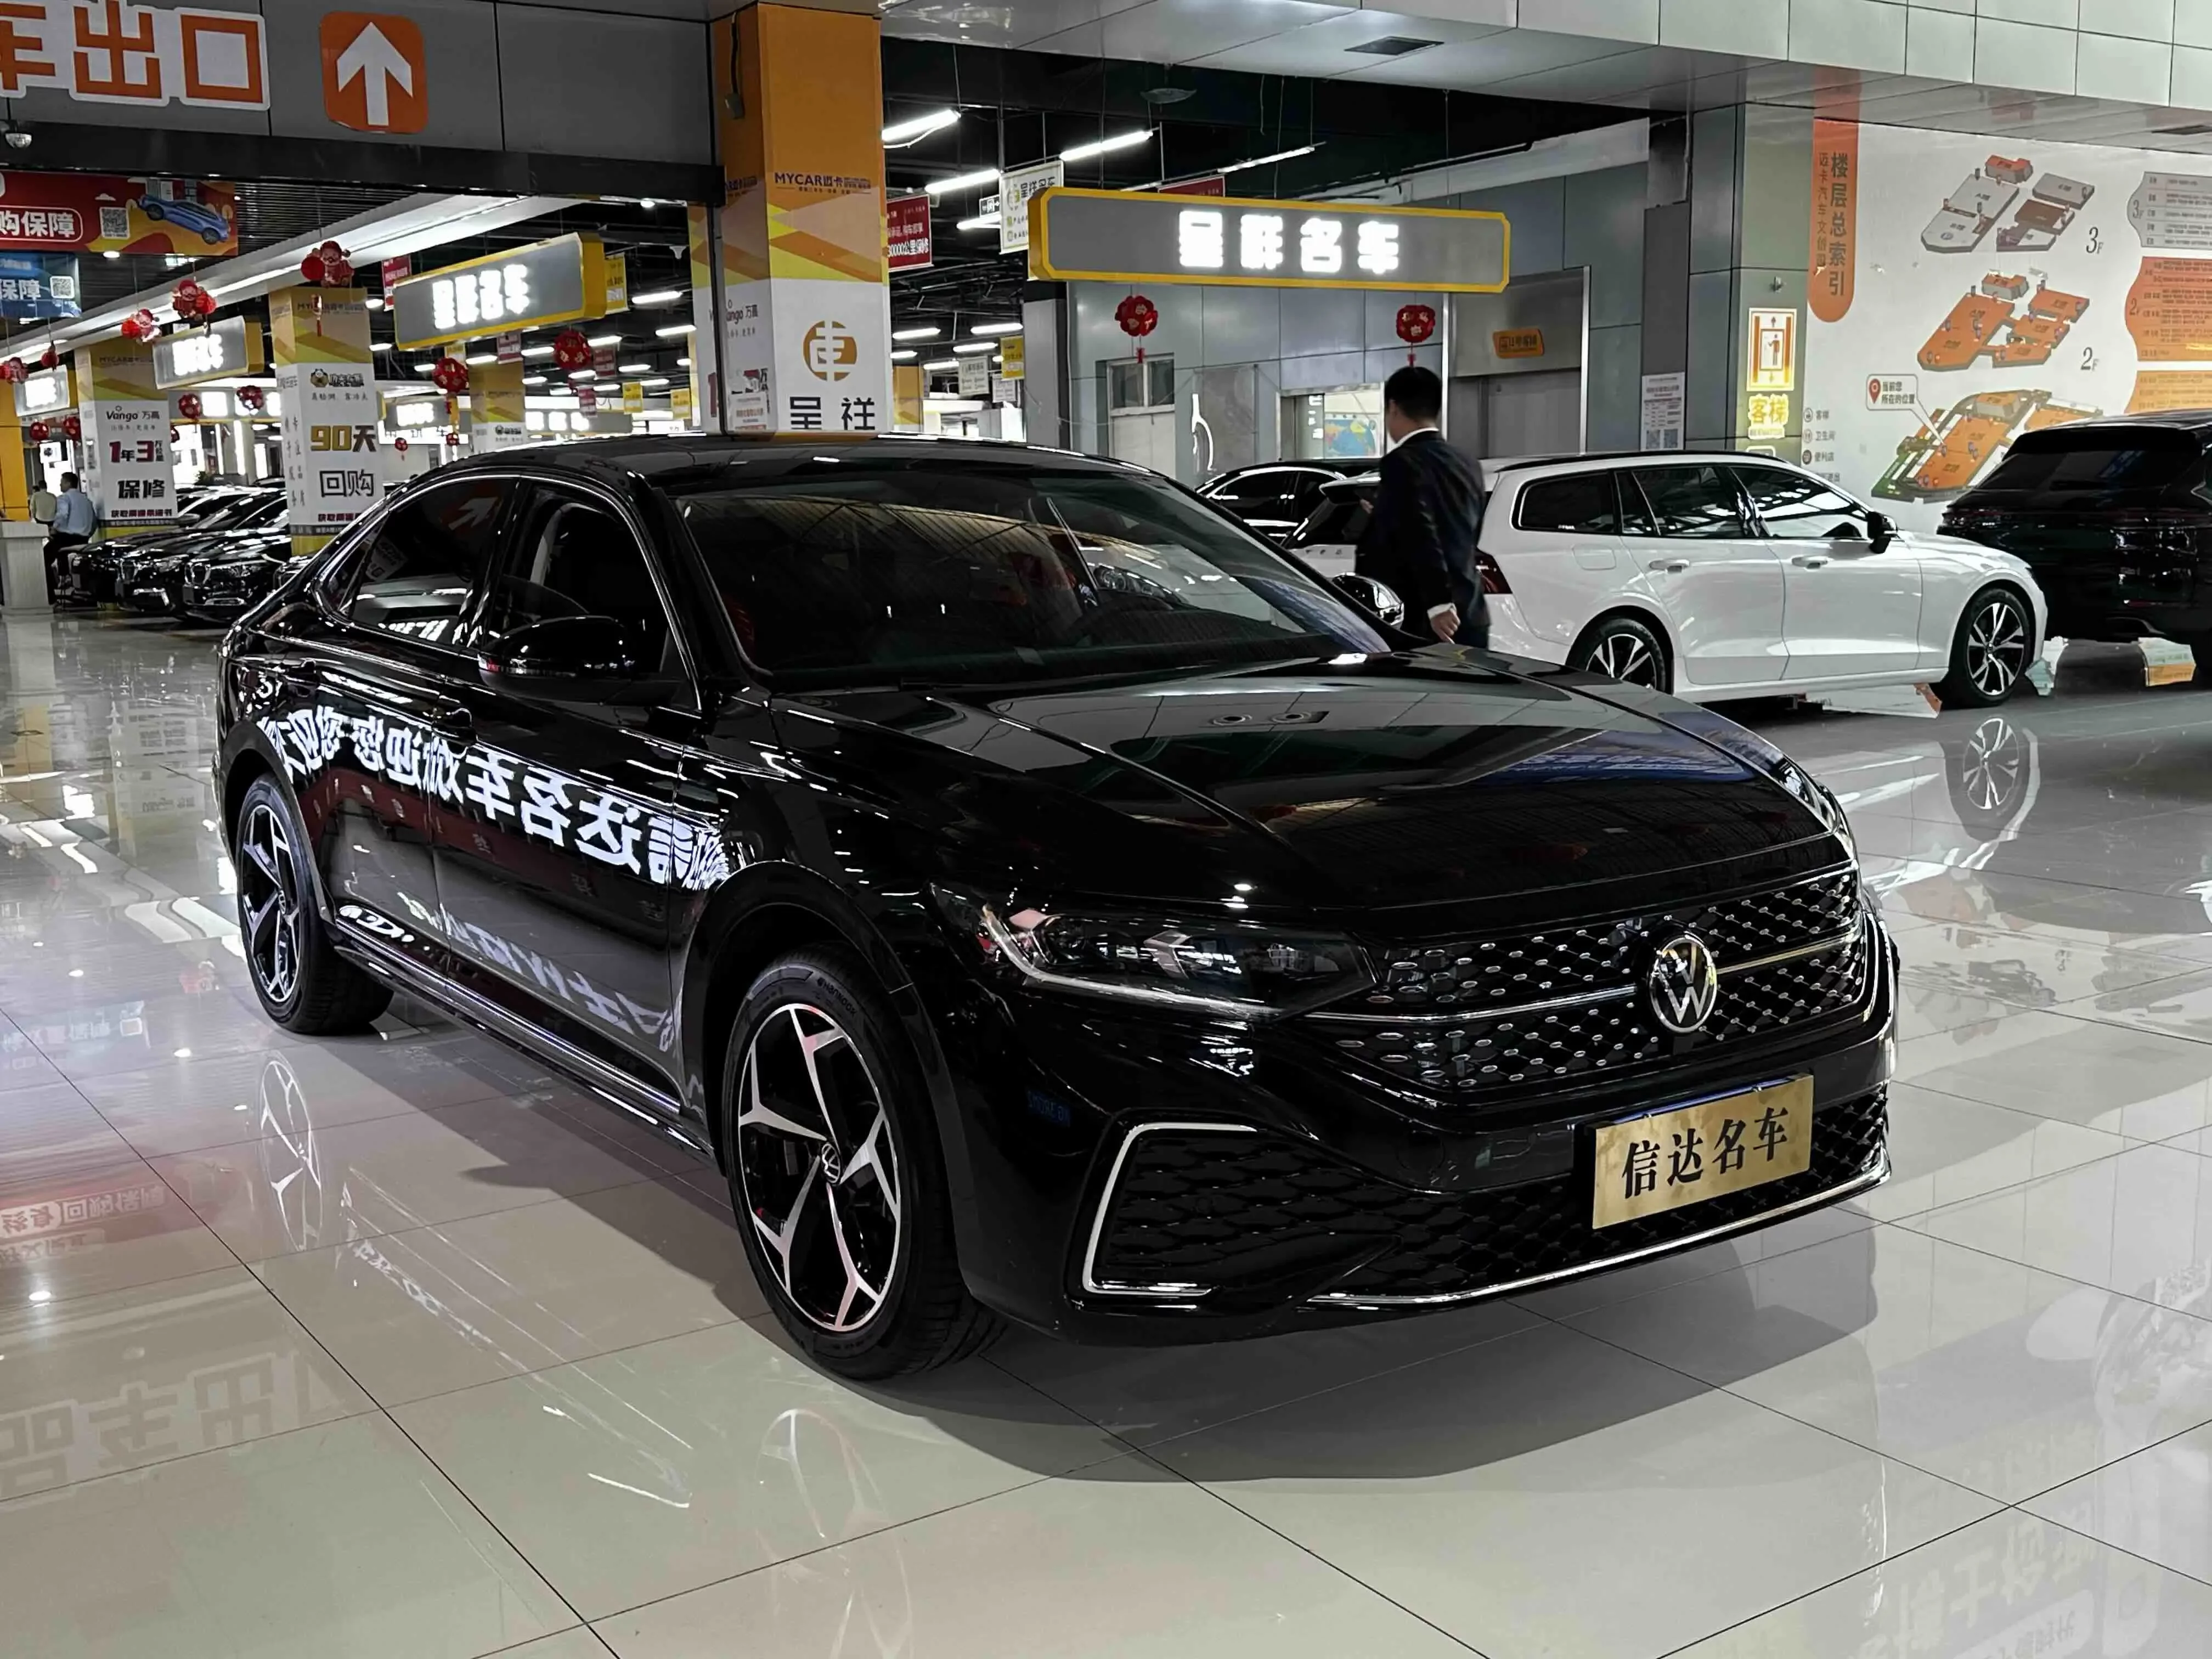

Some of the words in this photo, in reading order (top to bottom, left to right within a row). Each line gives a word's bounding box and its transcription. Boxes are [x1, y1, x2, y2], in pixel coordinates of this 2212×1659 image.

[774, 172, 822, 187] MYCAR
[1829, 151, 1848, 296] 楼层总索引
[1750, 397, 1787, 424] 客梯
[1881, 394, 1915, 404] 所在的位置
[106, 410, 138, 422] Vango
[789, 396, 876, 431] 呈祥
[311, 425, 376, 453] 90天
[118, 479, 165, 499] 保修
[319, 469, 374, 498] 回购
[1622, 1107, 1789, 1199] 信达名车
